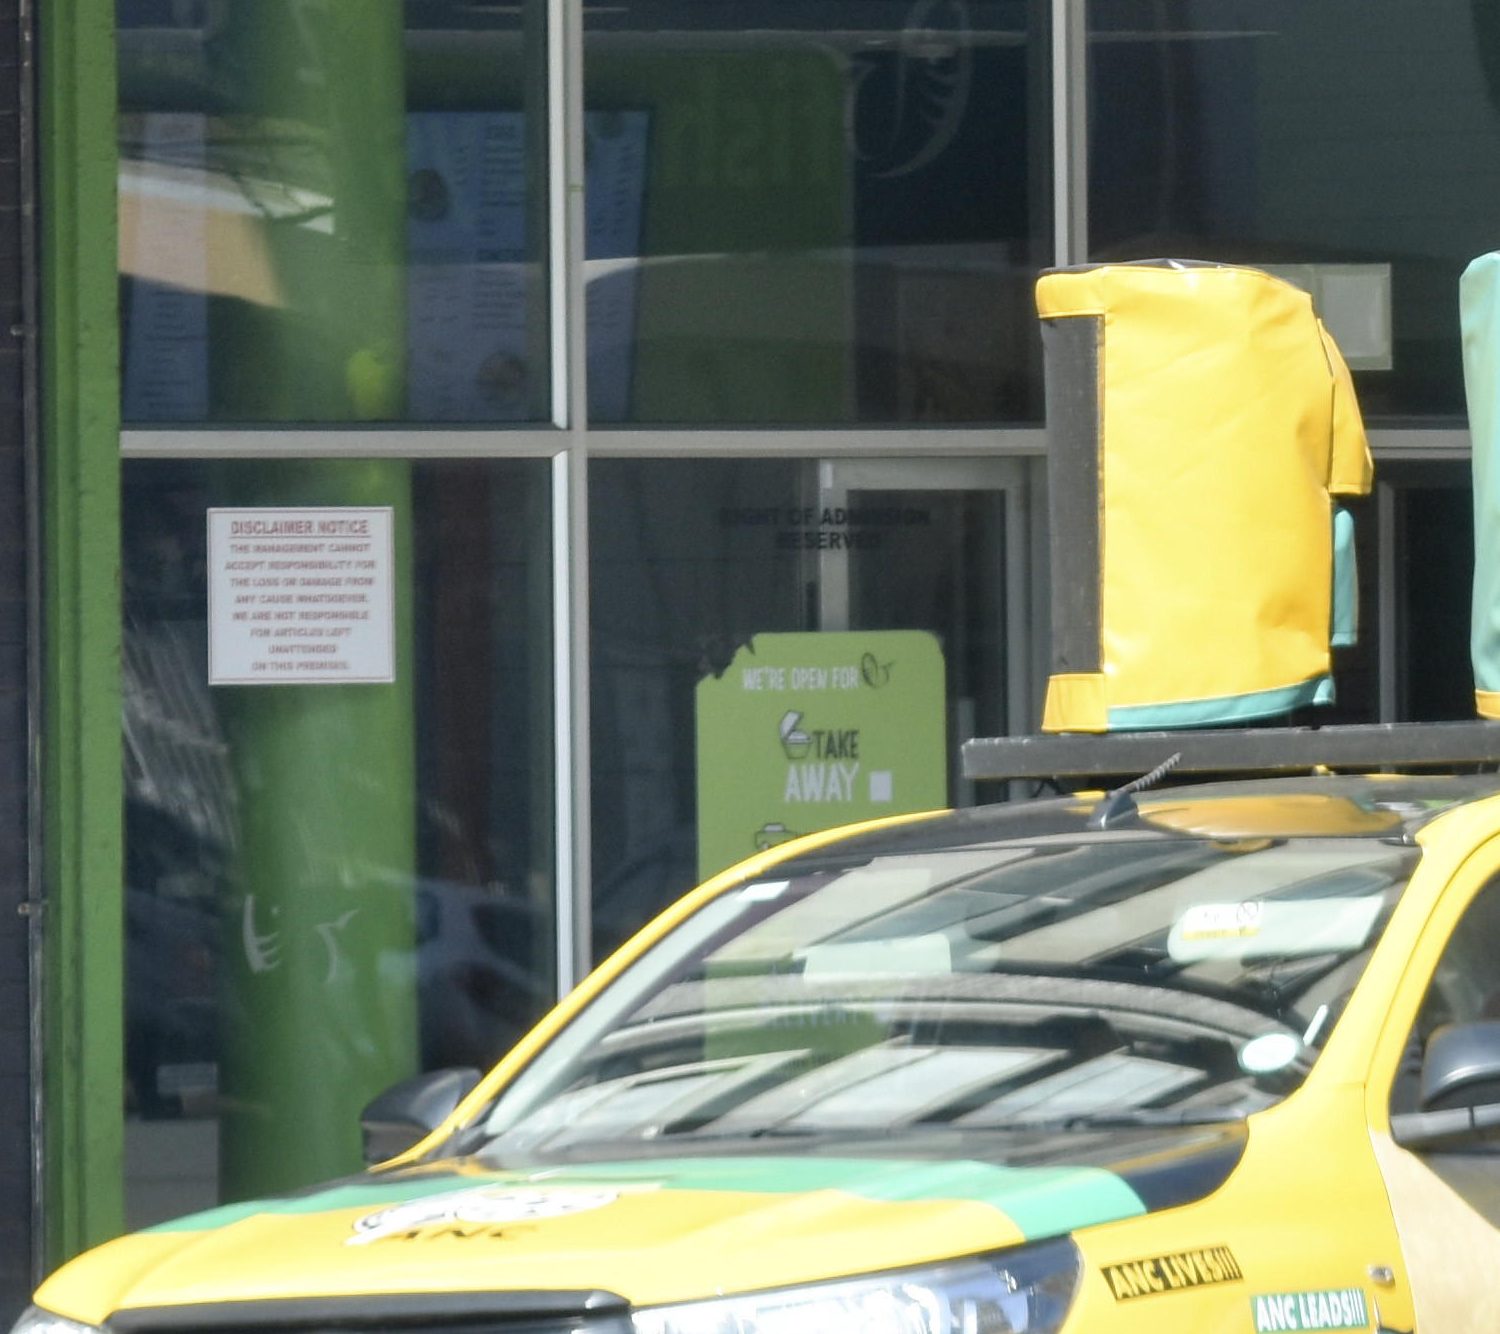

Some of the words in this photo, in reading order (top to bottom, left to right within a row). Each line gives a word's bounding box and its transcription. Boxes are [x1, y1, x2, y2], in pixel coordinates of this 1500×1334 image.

[230, 519, 313, 535] DISCLAIMER
[317, 519, 370, 534] NOTICE
[742, 665, 786, 691] WE'RE
[791, 665, 828, 689] OPEN
[831, 665, 860, 689] FOR
[812, 730, 861, 760] TAKE
[783, 762, 861, 804] AWAY
[1106, 1258, 1167, 1301] ANC
[1256, 1294, 1298, 1333] ANC
[1299, 1291, 1352, 1330] LEADS
